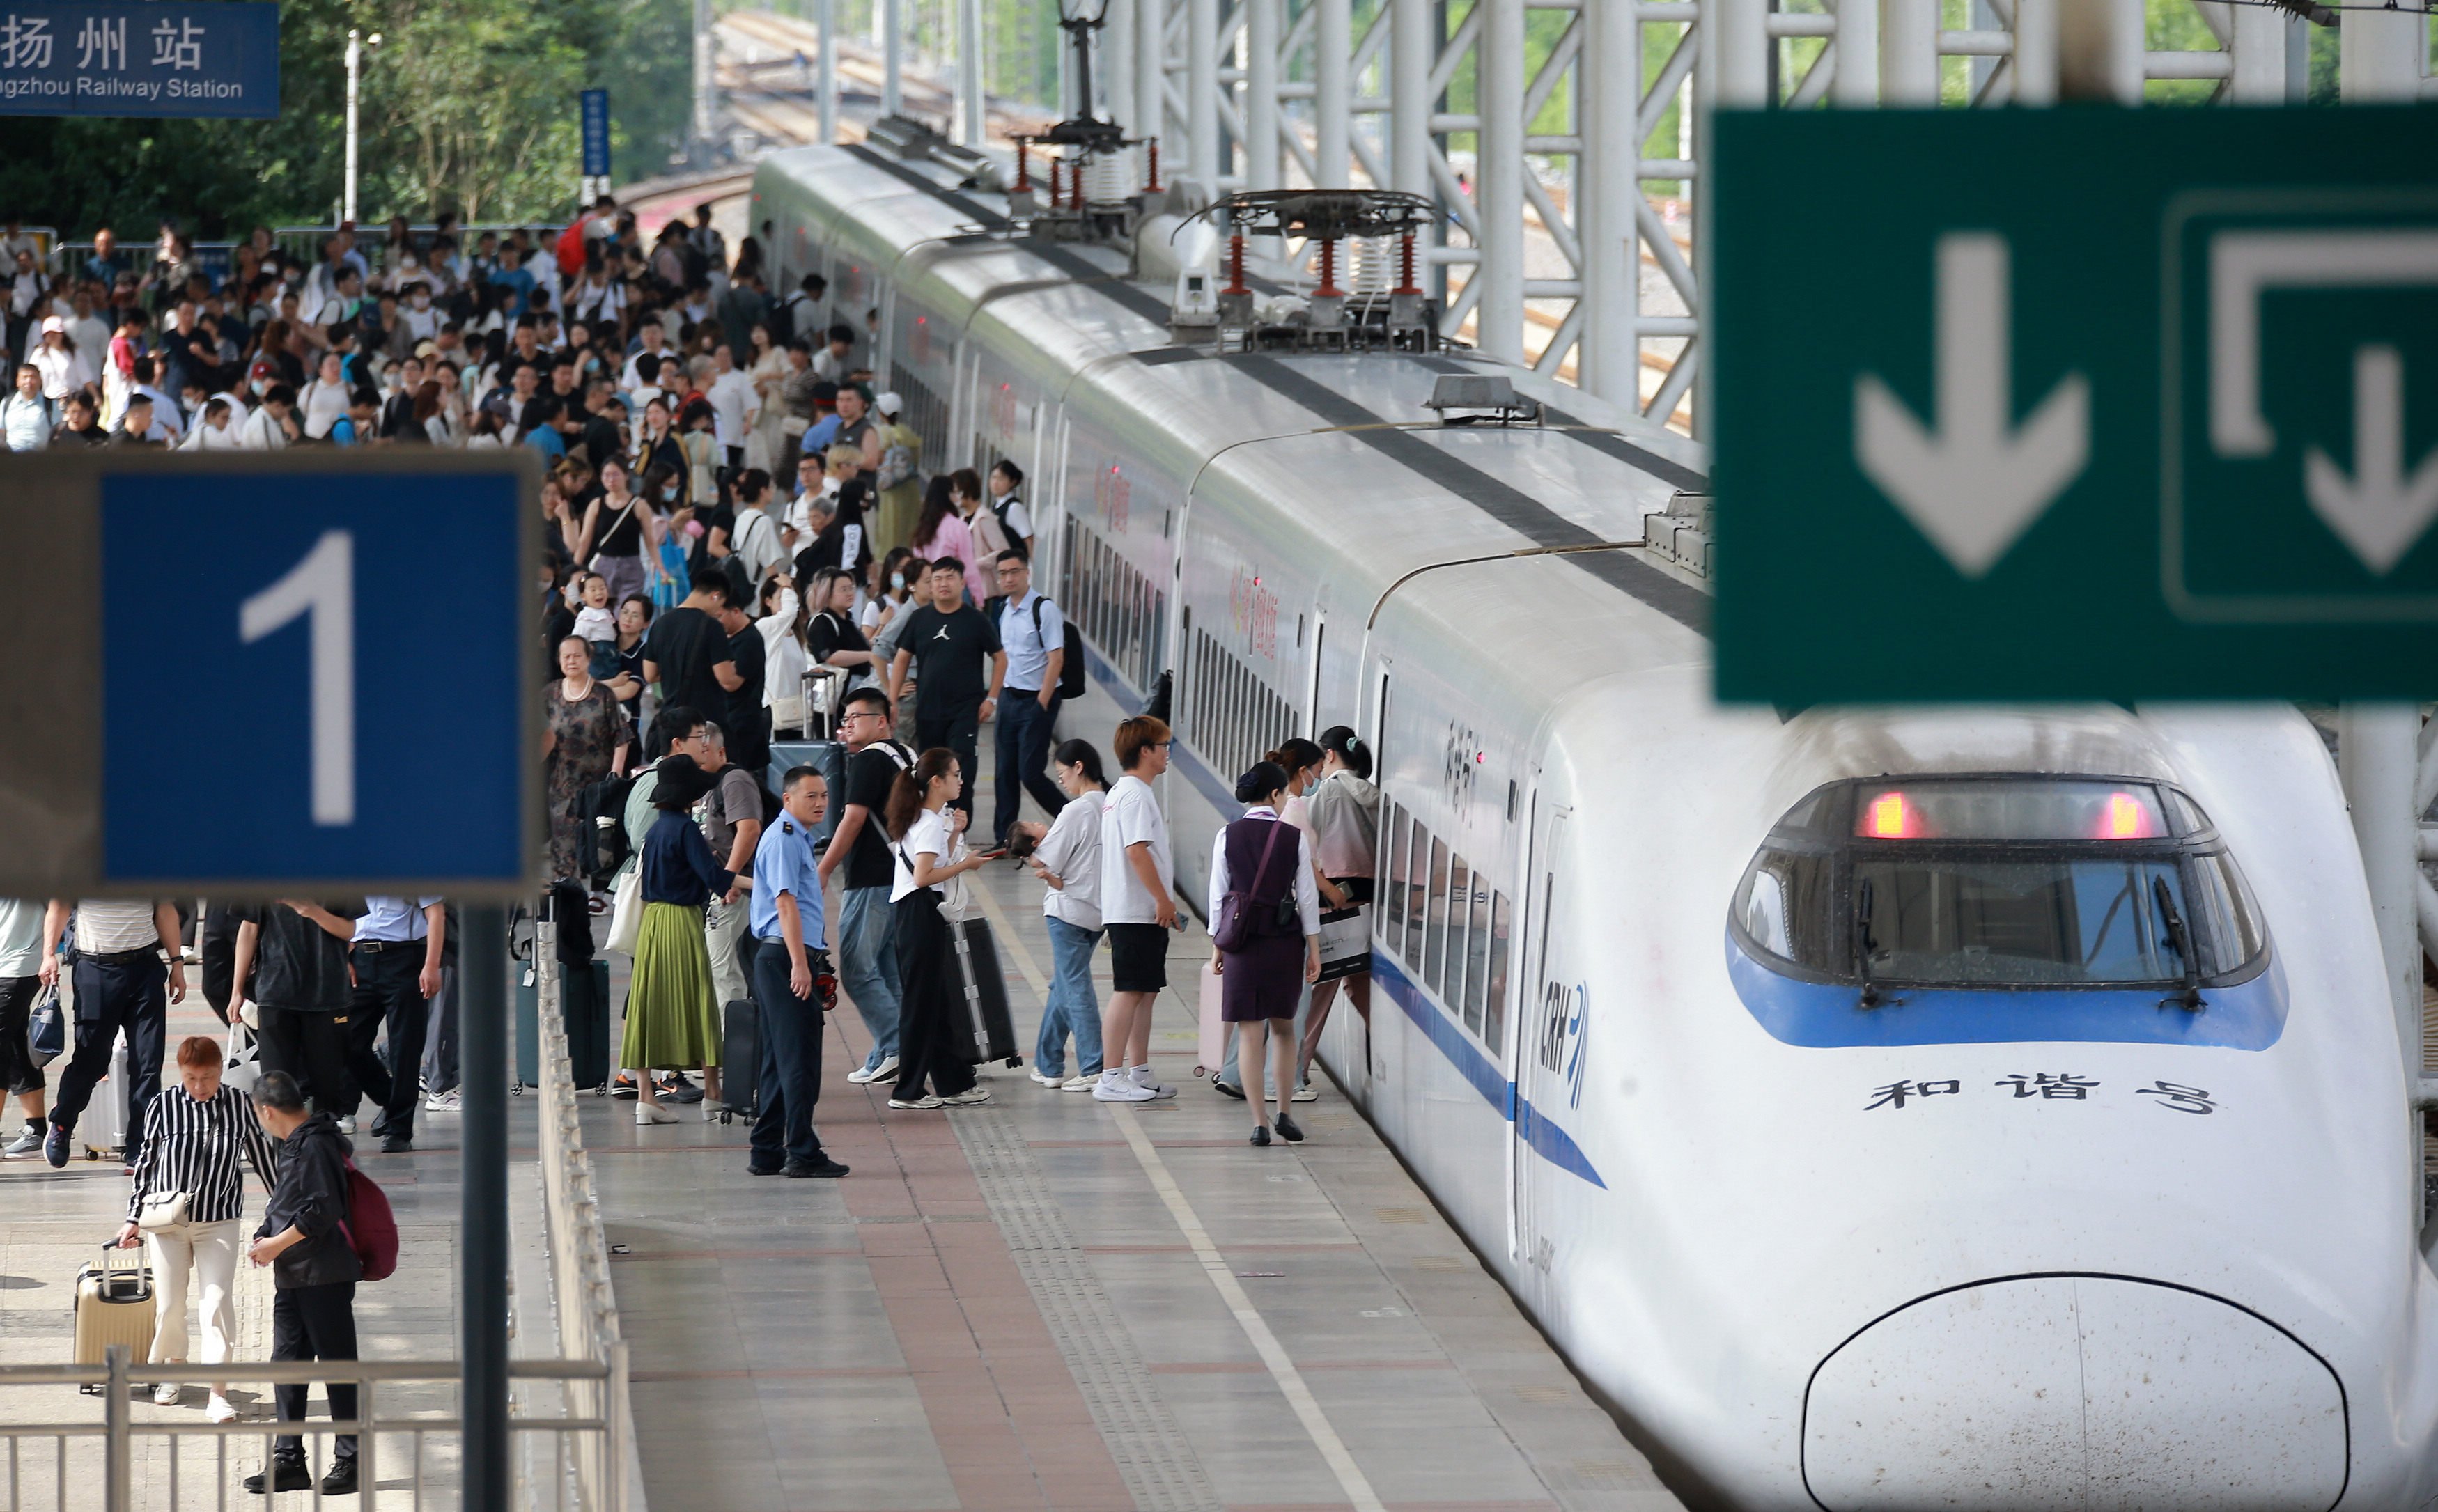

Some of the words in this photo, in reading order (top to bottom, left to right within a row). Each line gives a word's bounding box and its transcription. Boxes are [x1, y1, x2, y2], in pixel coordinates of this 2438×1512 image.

[0, 15, 205, 70] 扬州站
[0, 77, 69, 99] gzhou
[76, 77, 160, 101] Railway
[166, 78, 242, 98] Station
[240, 529, 353, 825] 1
[1542, 980, 1571, 1075] CRH
[1863, 1073, 2225, 1115] 和谐号
